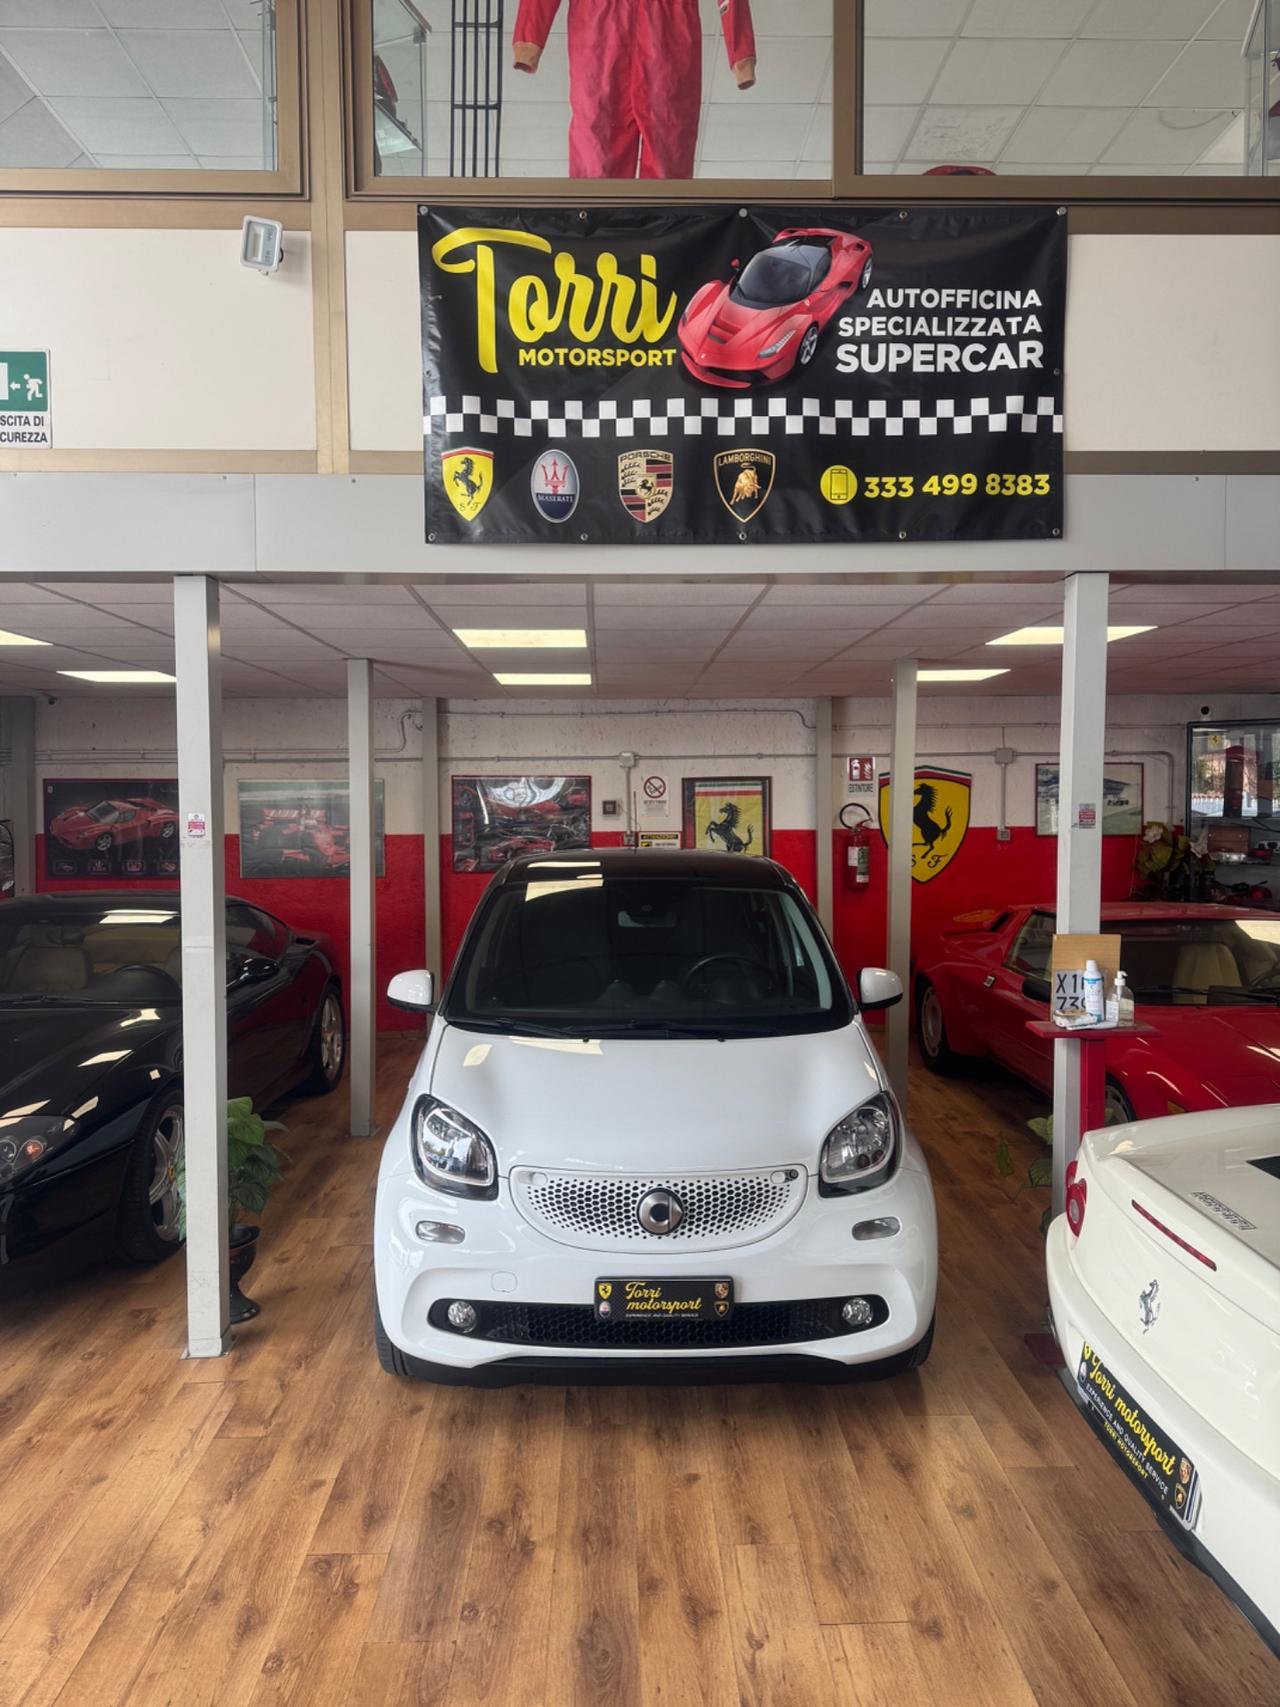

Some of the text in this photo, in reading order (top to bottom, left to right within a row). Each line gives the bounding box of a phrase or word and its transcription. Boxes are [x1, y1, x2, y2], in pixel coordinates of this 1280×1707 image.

[432, 227, 677, 373] Torri
[866, 288, 1042, 310] AUTOFFICINA
[838, 314, 1043, 337] SPECIALIZZATA
[519, 348, 676, 367] MOTORSPORT
[835, 340, 1044, 373] SUPERCAR
[33, 415, 44, 427] DI
[620, 451, 671, 462] PORSCHE
[718, 452, 772, 466] LAMBORGHINI
[864, 473, 1050, 498] 333 499 8383
[538, 494, 574, 503] MASERATI
[625, 1281, 662, 1300] Torri
[626, 1298, 702, 1314] motorsport
[1090, 1354, 1176, 1476] Torri motorsport
[1086, 1384, 1169, 1495] EXPERIENCE AND QUALITY SERVICE
